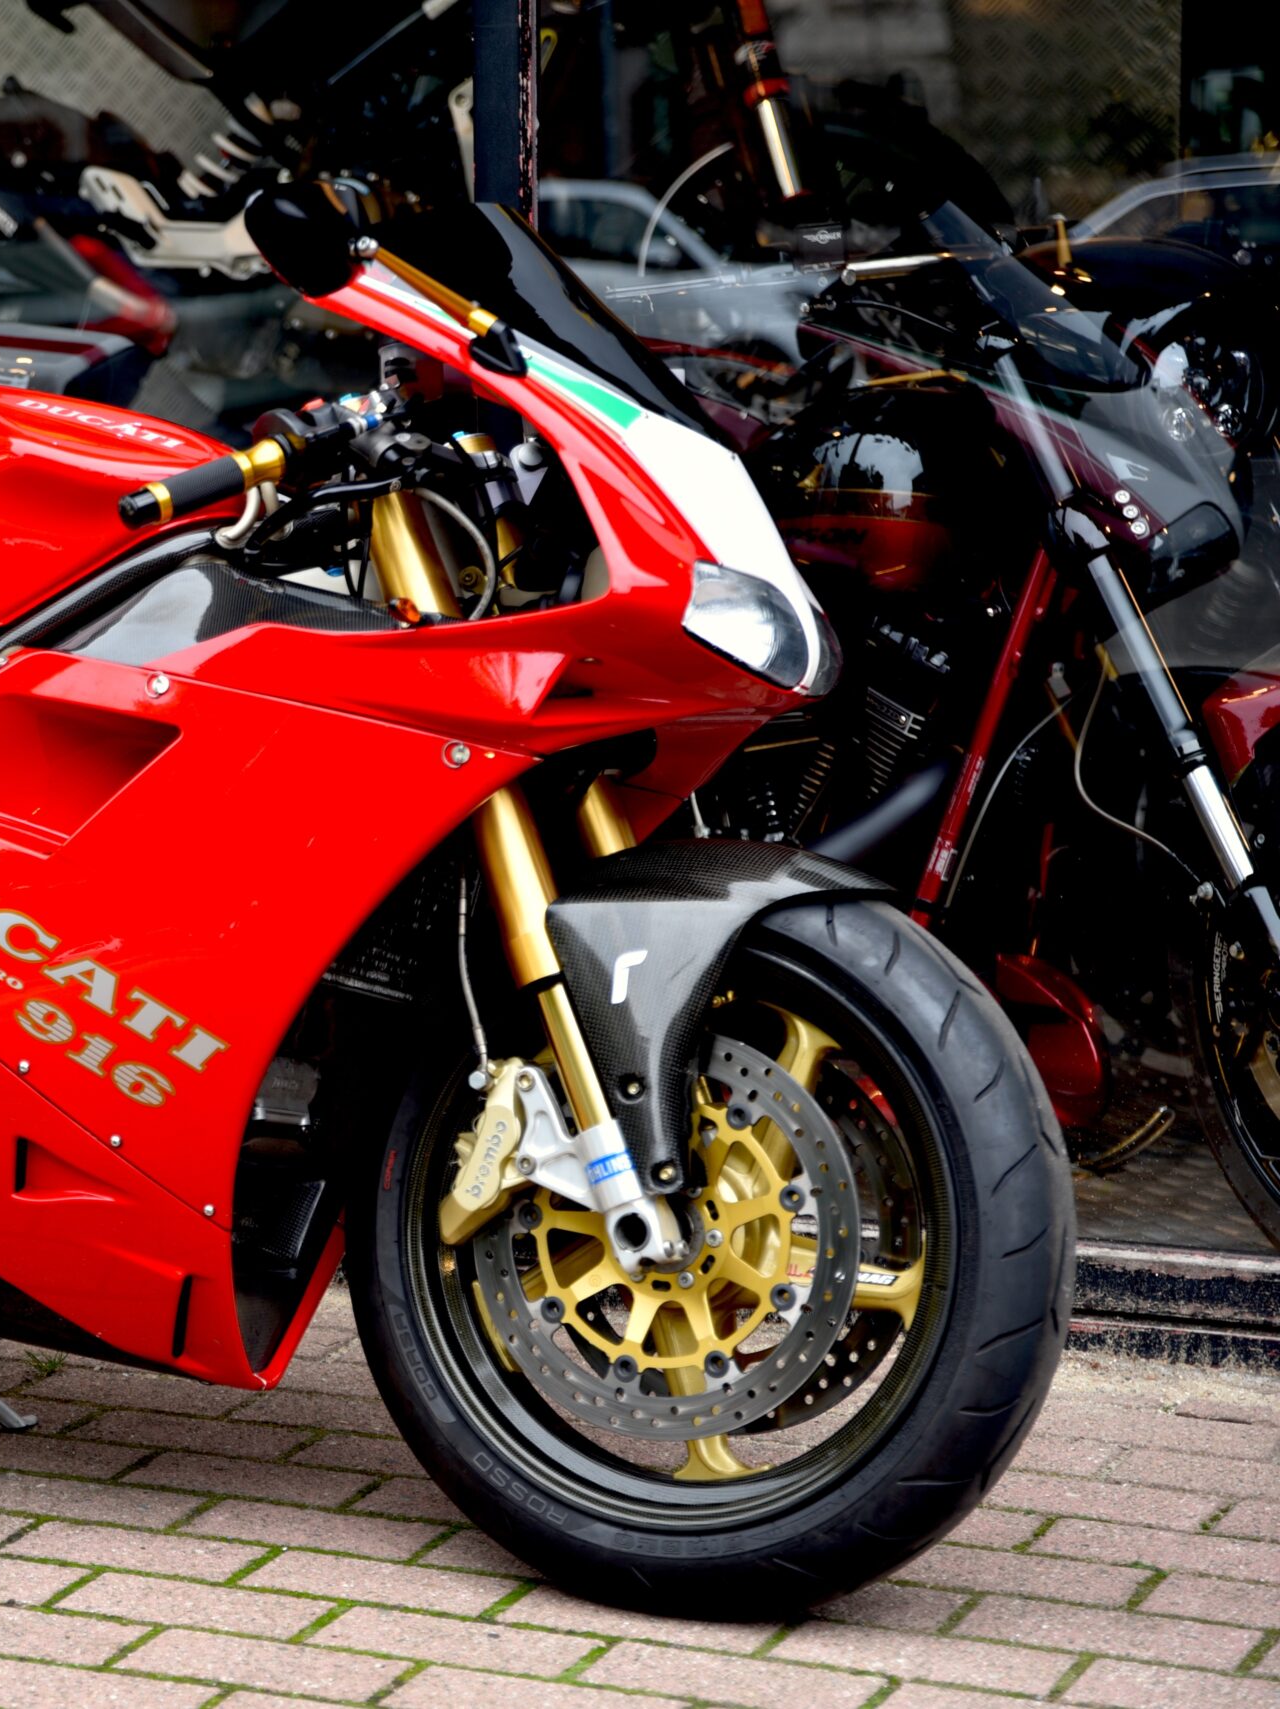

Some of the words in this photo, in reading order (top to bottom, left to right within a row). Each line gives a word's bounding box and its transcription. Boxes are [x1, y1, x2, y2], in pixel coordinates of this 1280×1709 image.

[16, 399, 186, 448] DUCATI
[13, 997, 177, 1108] 916
[465, 1119, 508, 1199] brembo
[393, 1311, 438, 1402] CORSA
[472, 1450, 570, 1527] ROSSO
